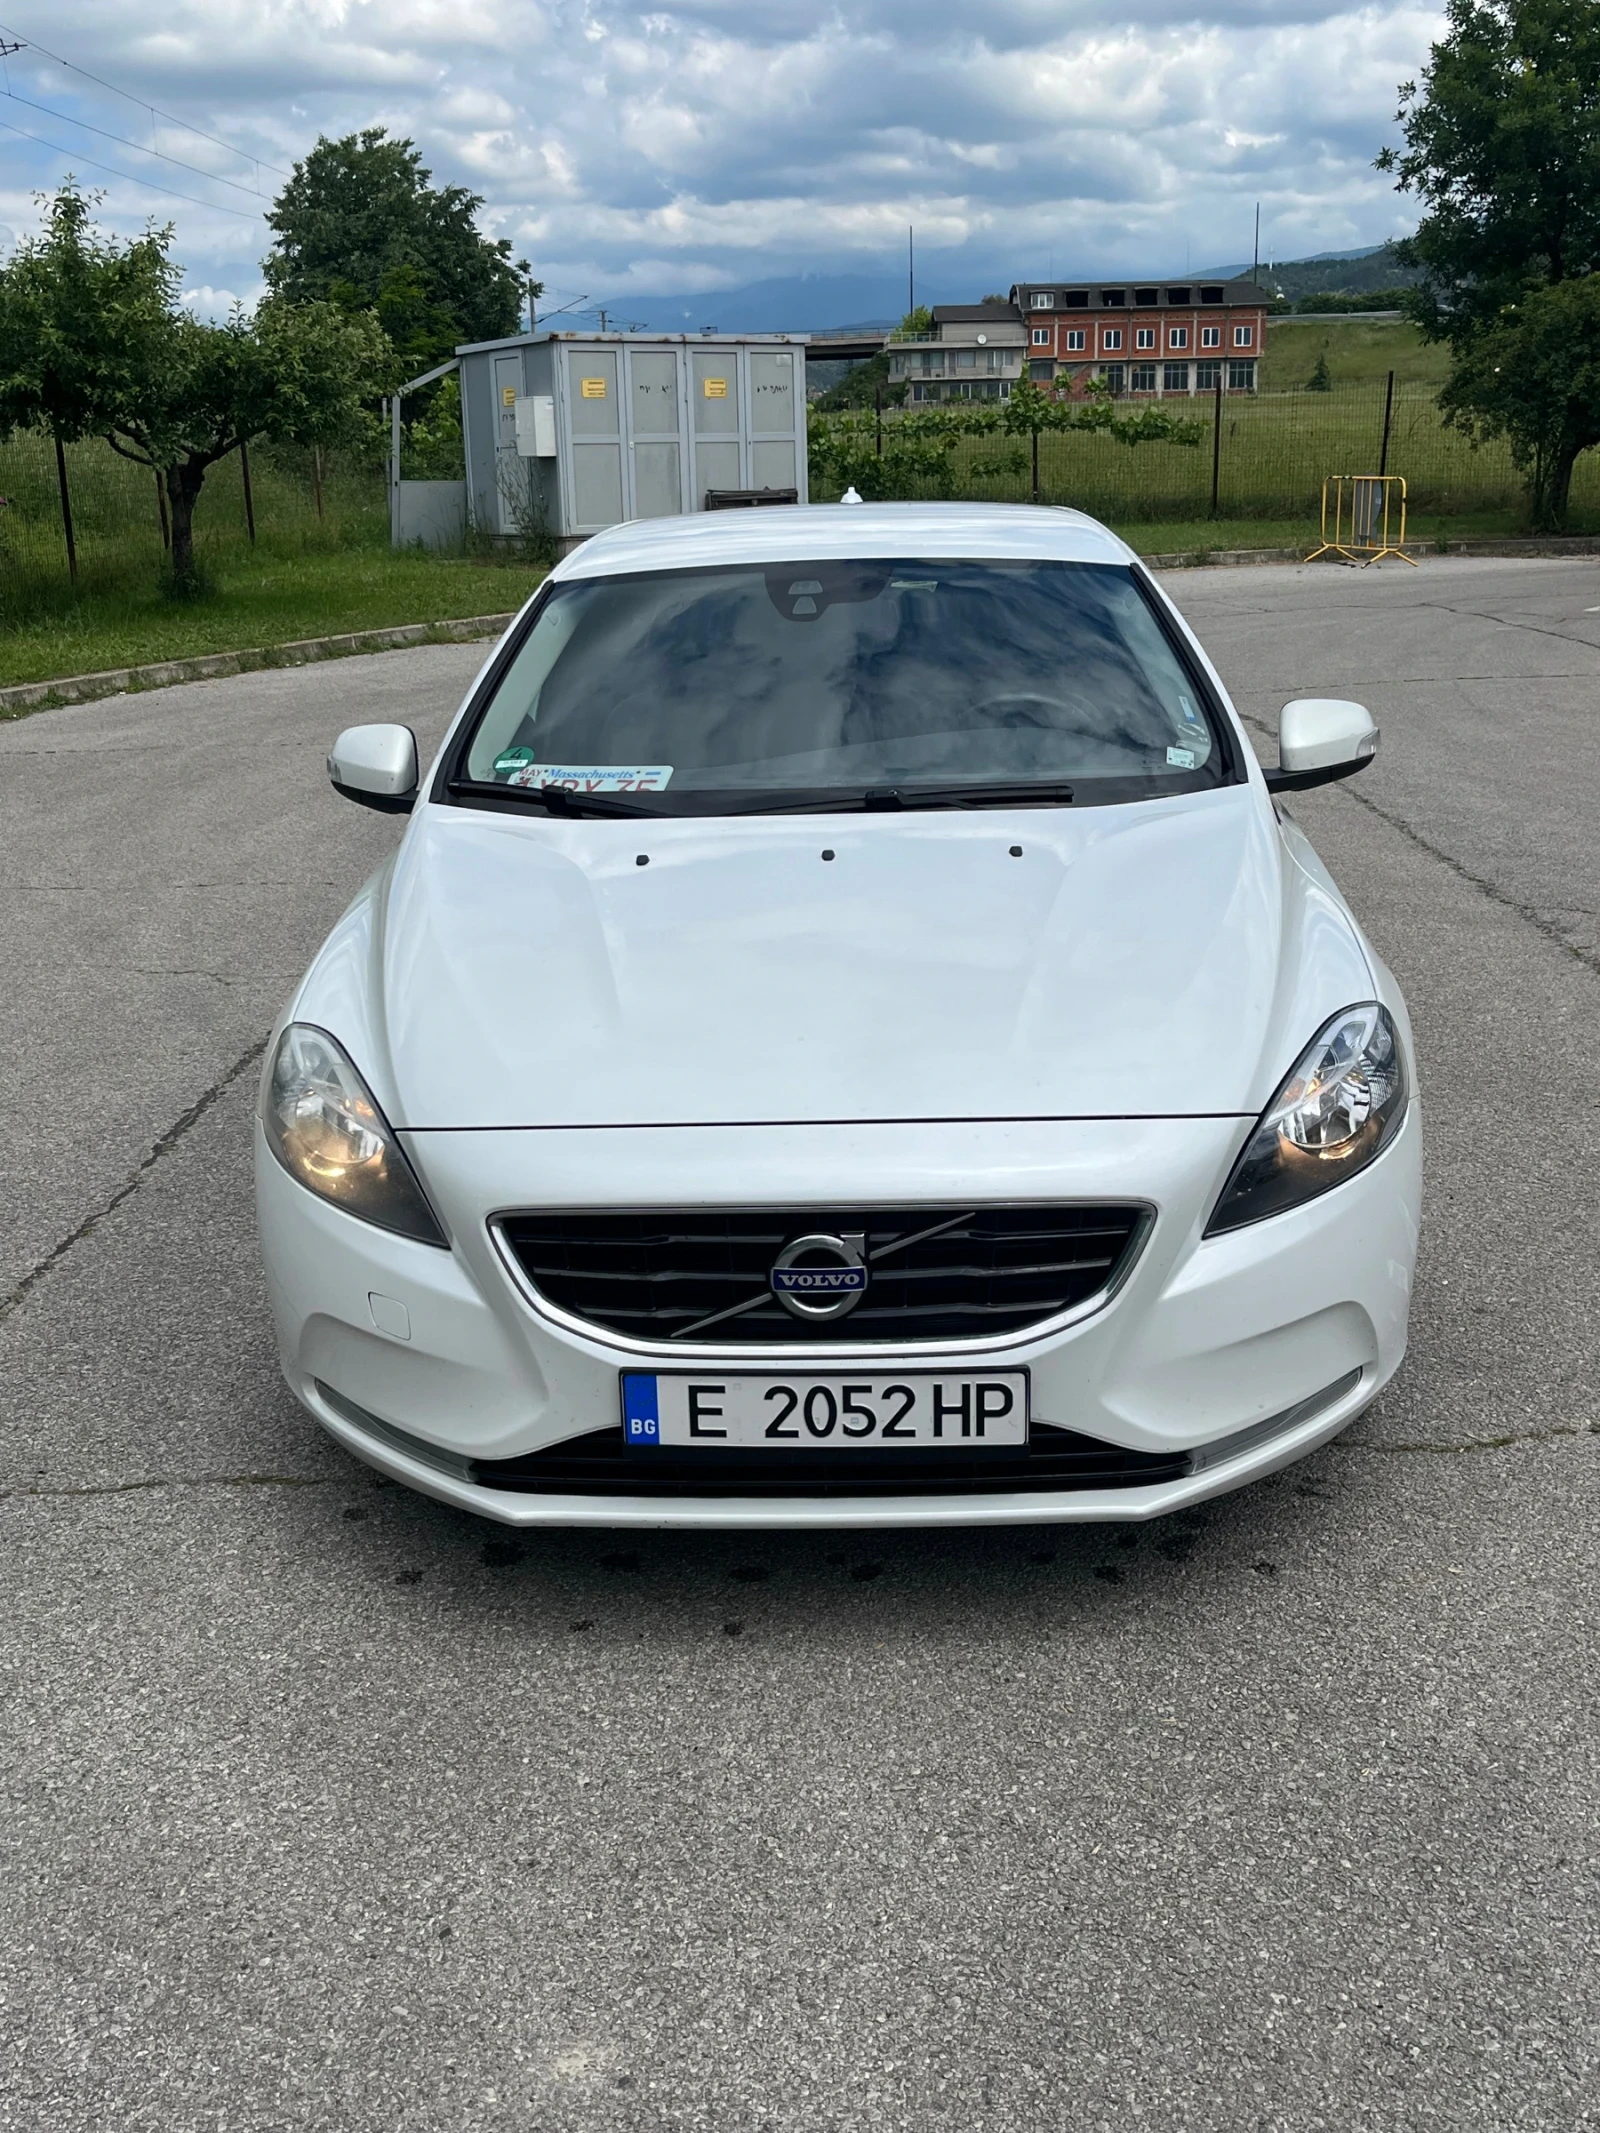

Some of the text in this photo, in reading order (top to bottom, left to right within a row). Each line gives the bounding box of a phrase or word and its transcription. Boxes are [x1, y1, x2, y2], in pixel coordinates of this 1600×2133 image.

[510, 748, 523, 760] 4
[519, 768, 542, 777] MAY
[547, 769, 634, 779] Massachusetts
[778, 1273, 860, 1287] VOLVO
[688, 1383, 1013, 1438] E 2052 HP
[631, 1419, 656, 1434] BG
